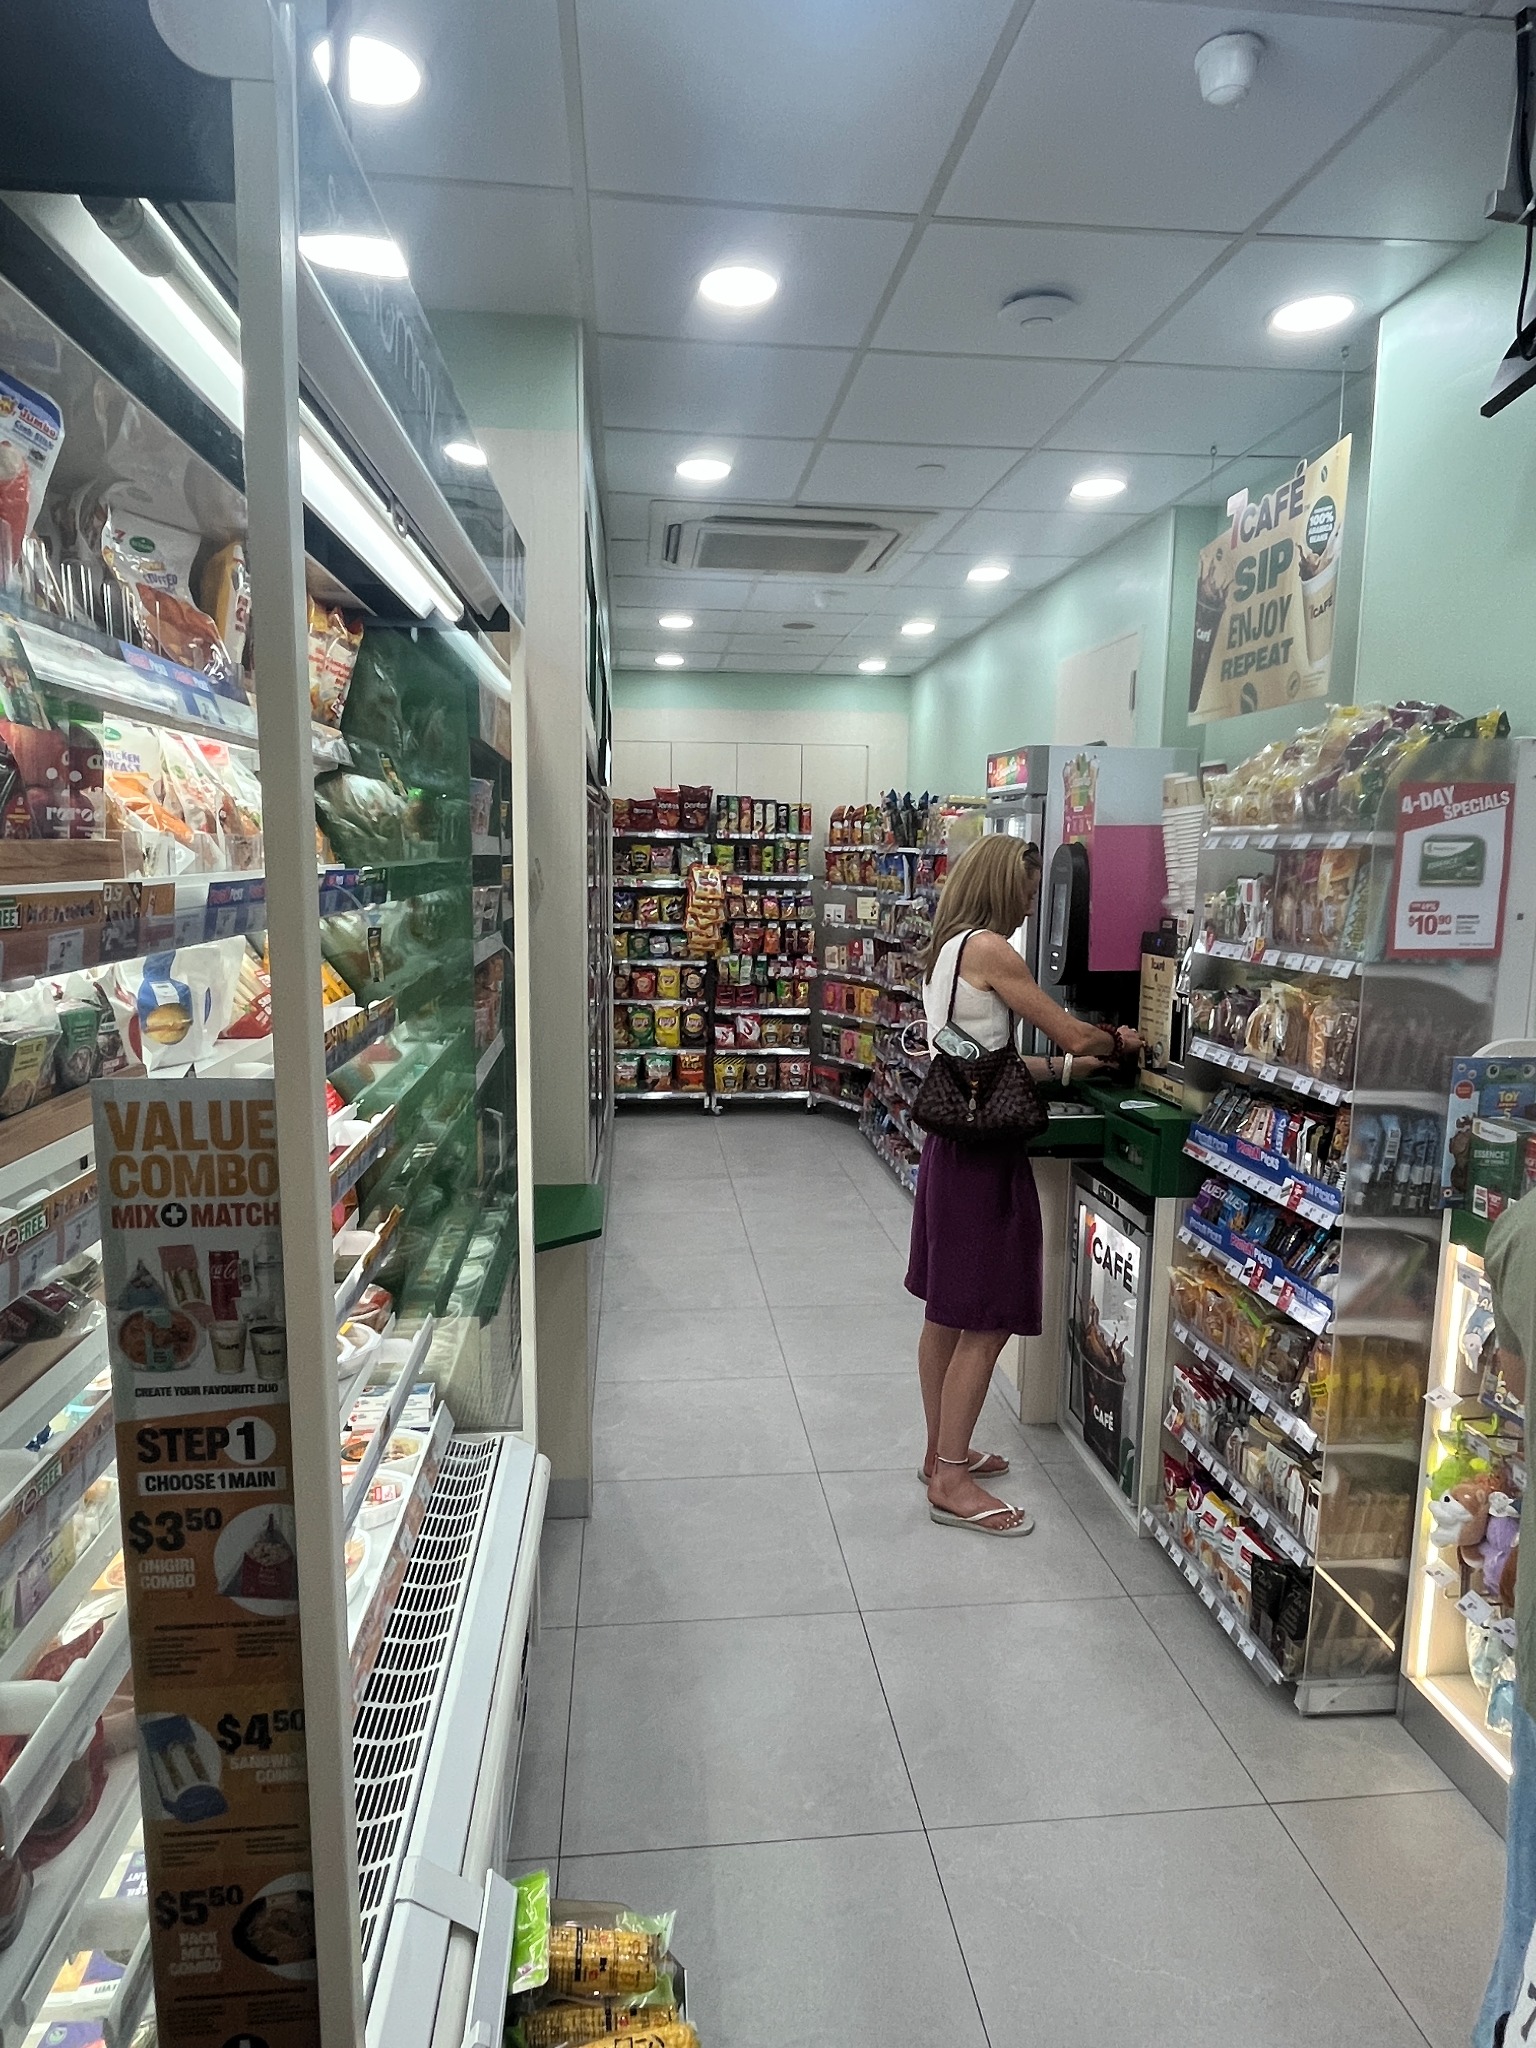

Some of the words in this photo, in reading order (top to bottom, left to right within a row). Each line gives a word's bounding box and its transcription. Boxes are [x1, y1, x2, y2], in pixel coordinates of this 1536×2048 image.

[1309, 511, 1334, 526] 100%
[1233, 537, 1294, 603] SIP
[1226, 594, 1293, 650] ENJOY
[1220, 637, 1294, 683] REPEAT
[104, 750, 140, 764] HICKEN
[1401, 785, 1456, 815] 4-DAY
[1443, 790, 1511, 820] SPECIALS
[1498, 1091, 1520, 1102] TOY
[104, 1099, 276, 1151] VALUE
[1474, 1150, 1505, 1159] ESSENCE
[109, 1153, 279, 1198] COMBO
[1201, 1180, 1227, 1201] QUEST
[19, 1216, 44, 1241] FREE
[111, 1205, 160, 1229] MIX
[191, 1202, 280, 1228] MATCH
[135, 1386, 172, 1398] CREATE
[173, 1385, 201, 1397] YOUR
[202, 1384, 256, 1396] FAVOURITE
[258, 1383, 278, 1394] DUO
[136, 1426, 230, 1464] STEP
[236, 1421, 256, 1461] 1
[144, 1473, 216, 1493] CHOOSE
[219, 1474, 227, 1490] 1
[228, 1470, 276, 1489] MAIN
[140, 1573, 196, 1590] COMBO
